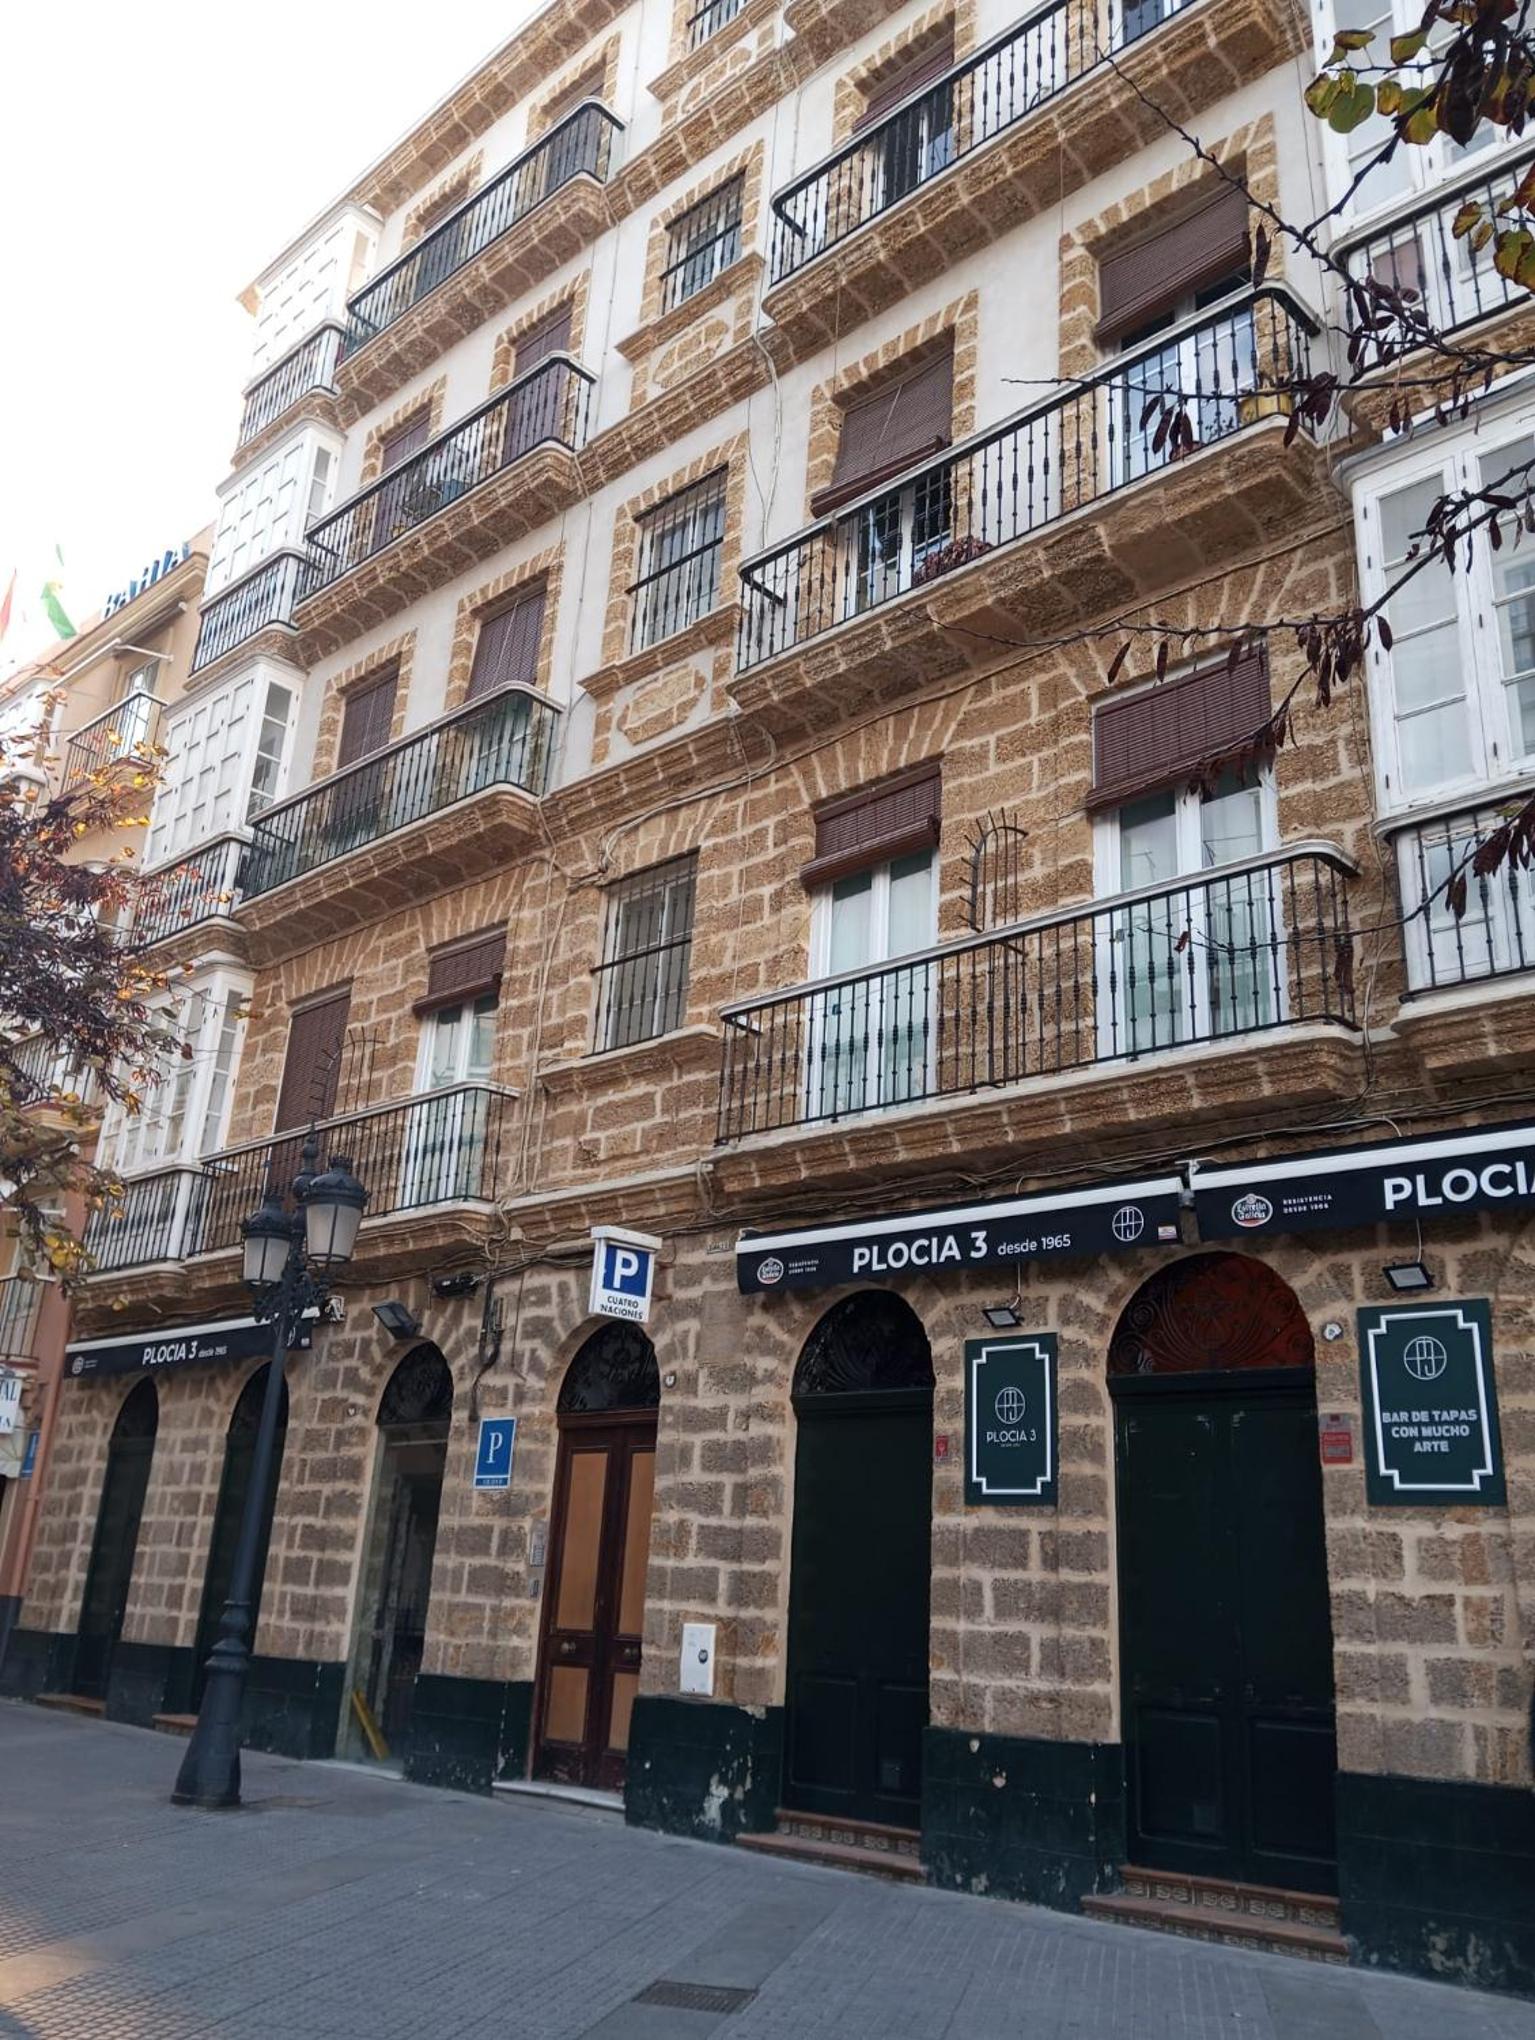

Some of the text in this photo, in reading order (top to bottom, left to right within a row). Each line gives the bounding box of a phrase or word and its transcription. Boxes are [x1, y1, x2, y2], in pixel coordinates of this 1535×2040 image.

[1384, 1161, 1535, 1210] PLOCI
[852, 1230, 1071, 1273] PLOCIA 3 desde 1965
[612, 1249, 639, 1289] P
[607, 1296, 639, 1309] CUATRO
[600, 1303, 644, 1320] NACIONES
[142, 1343, 186, 1366] PLOCIA
[188, 1340, 198, 1359] 3
[1382, 1409, 1478, 1423] BAR DE TAPAS
[986, 1428, 1037, 1443] PLOCIA 3
[1391, 1425, 1470, 1438] CON MUCHO
[485, 1431, 503, 1464] P
[1413, 1440, 1450, 1452] ARTE
